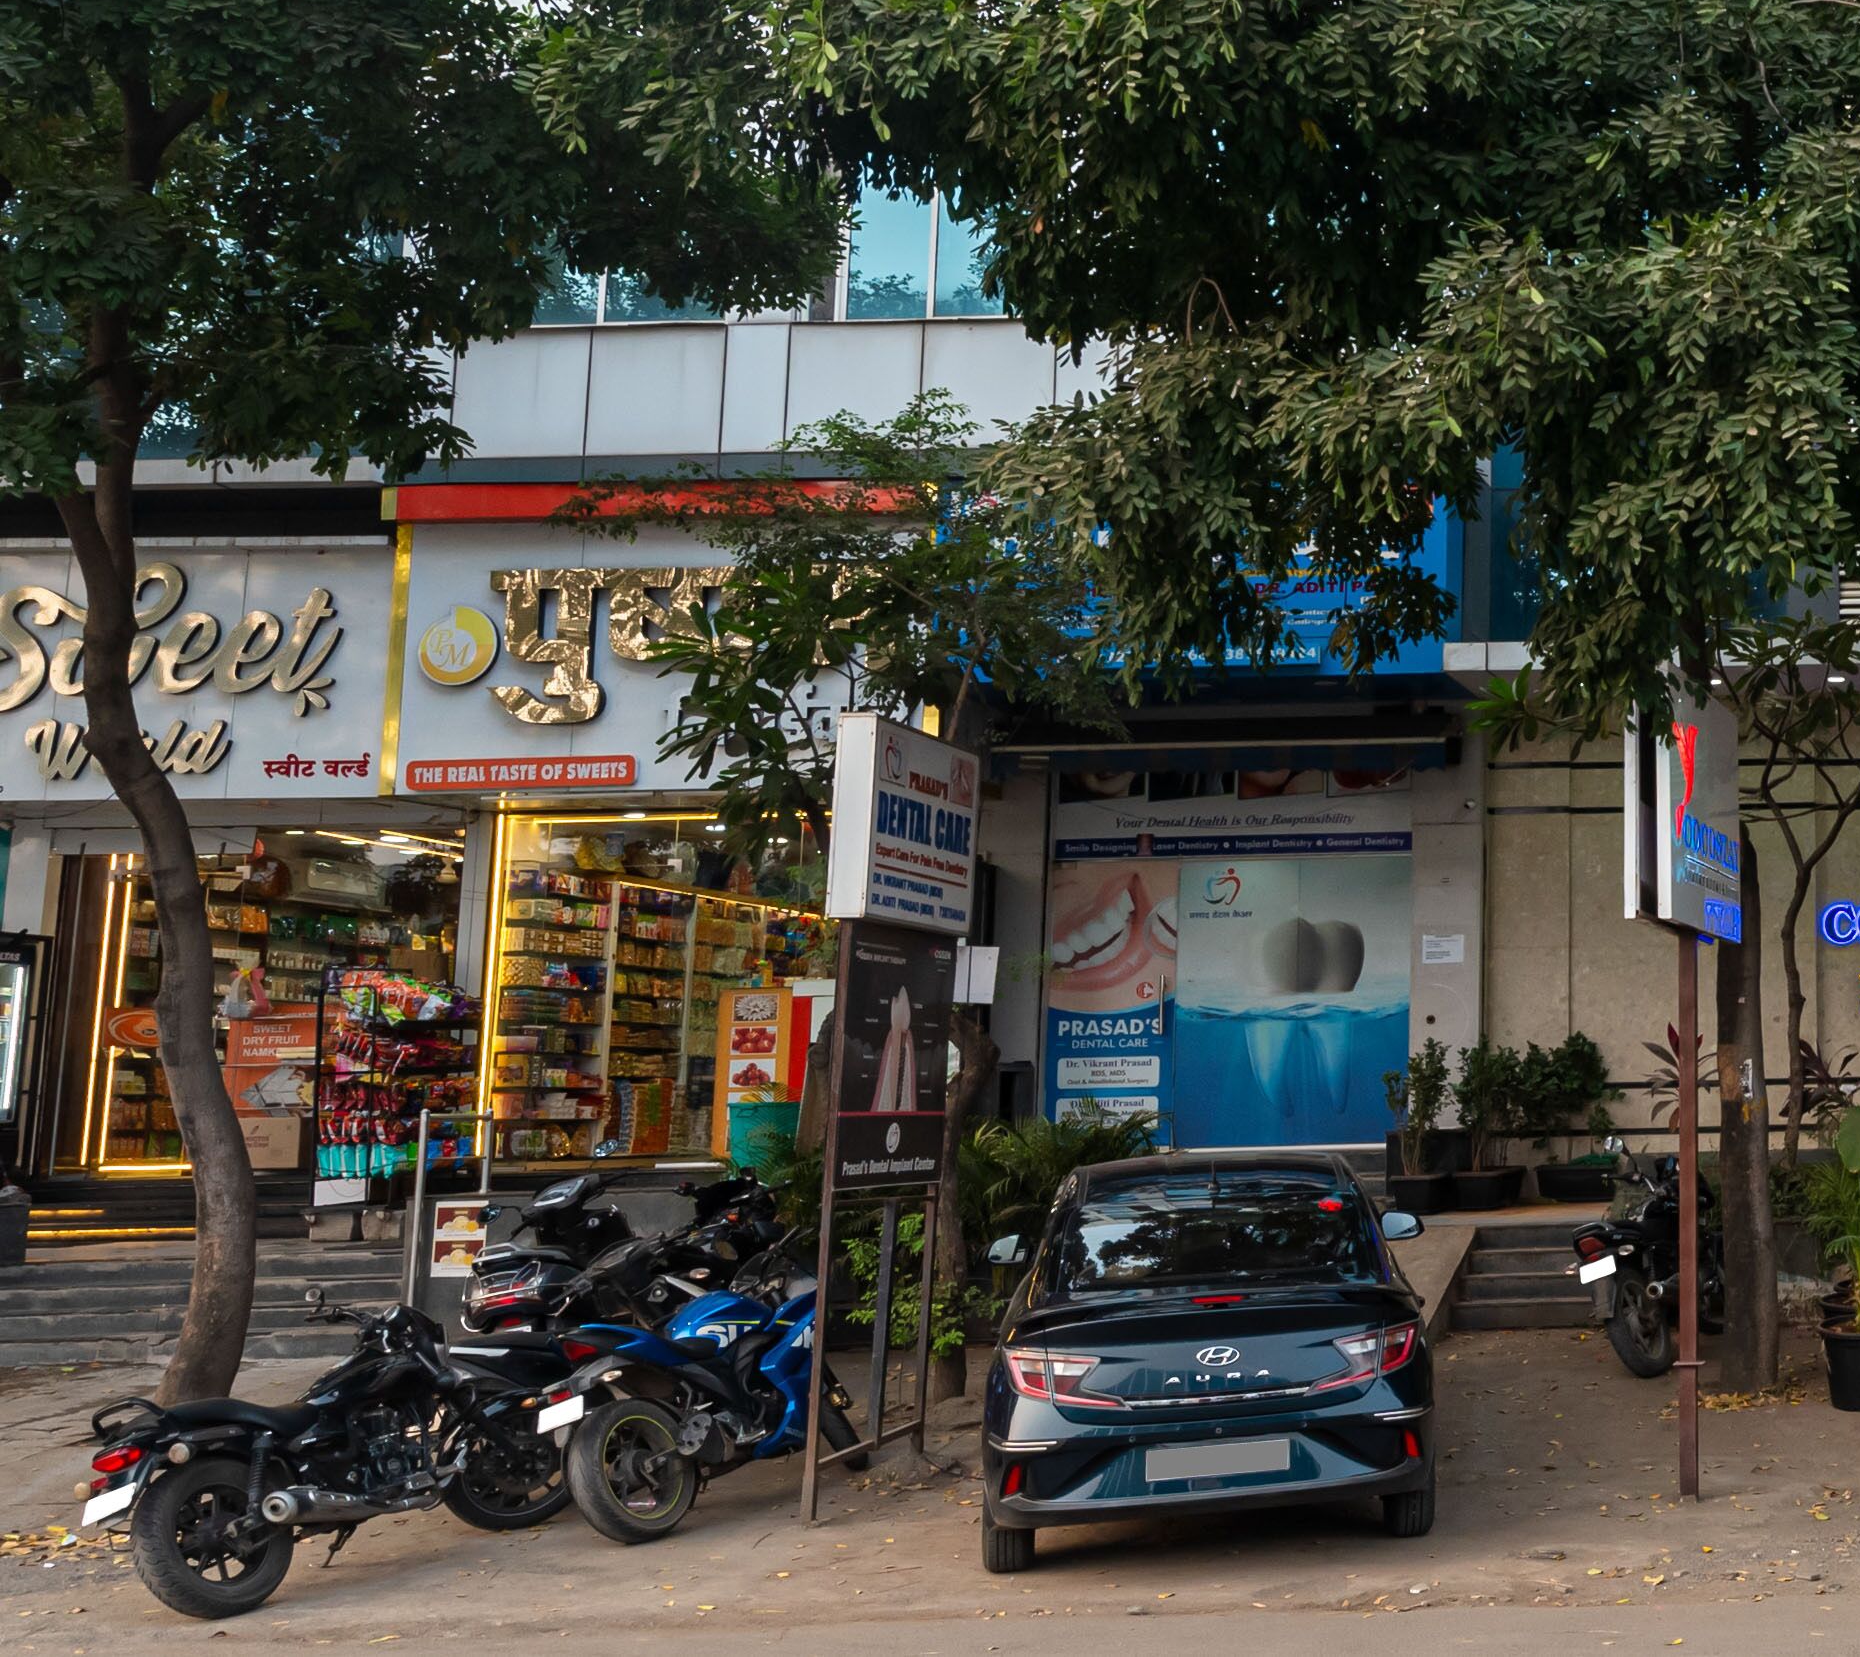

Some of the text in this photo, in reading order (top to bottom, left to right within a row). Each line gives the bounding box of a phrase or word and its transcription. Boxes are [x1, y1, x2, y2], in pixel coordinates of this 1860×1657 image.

[25, 718, 234, 781] Wld
[263, 753, 316, 779] स्वीट
[414, 761, 627, 784] THE REAL TASTE OF SWEETS
[876, 789, 972, 858] DENTAL CARE
[1115, 813, 1355, 829] Your Dental Health is Our Responsibility
[253, 1023, 292, 1034] SWEET
[1058, 1018, 1162, 1037] PRASAD'S
[242, 1034, 302, 1045] DRY FRUIT
[1071, 1037, 1149, 1049] DENTAL CARE
[1120, 1058, 1153, 1067] Prasad
[1165, 1369, 1270, 1385] AURA
